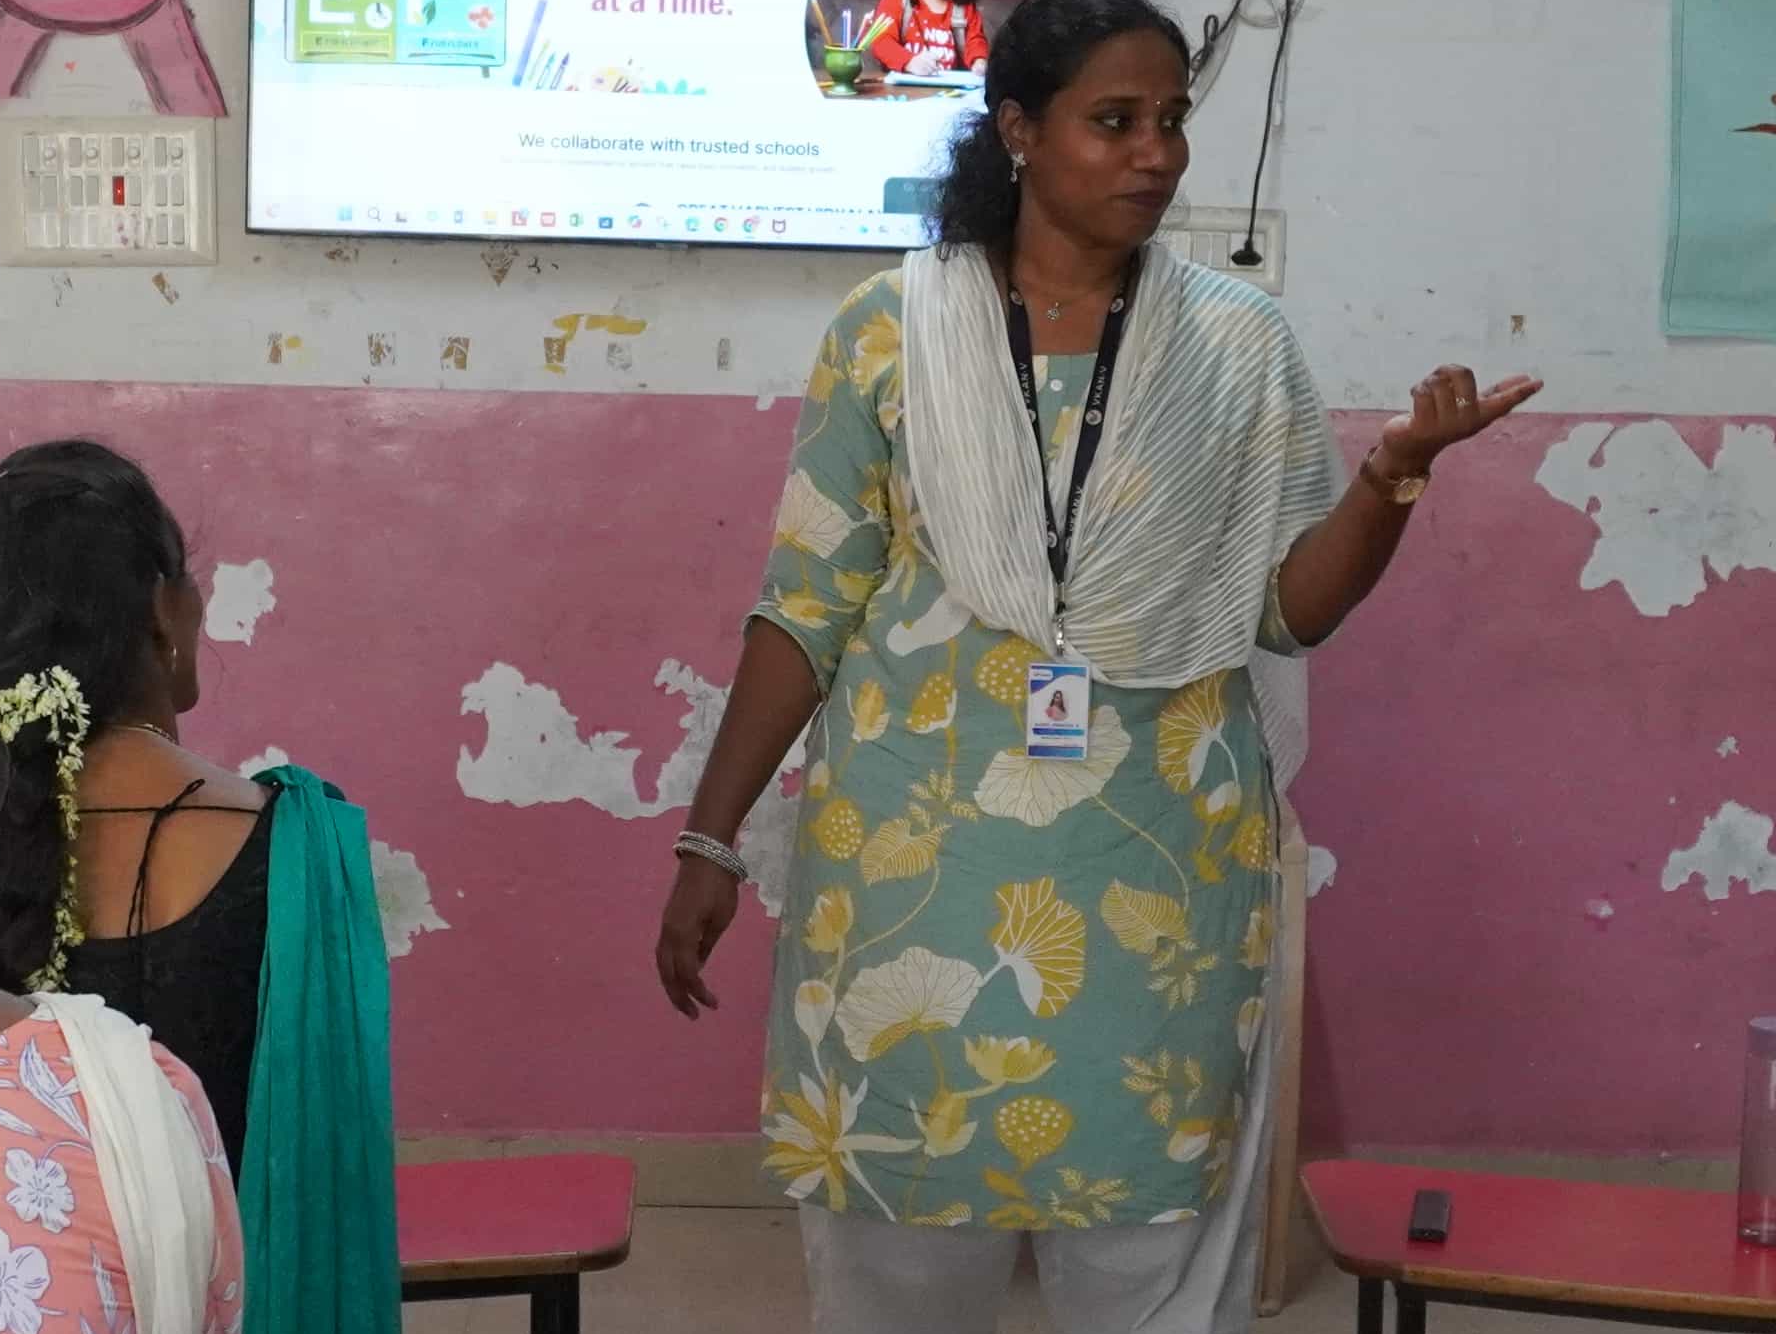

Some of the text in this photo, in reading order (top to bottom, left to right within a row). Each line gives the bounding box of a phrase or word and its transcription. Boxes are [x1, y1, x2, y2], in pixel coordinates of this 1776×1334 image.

[519, 133, 820, 157] We collaborate with trusted schools
